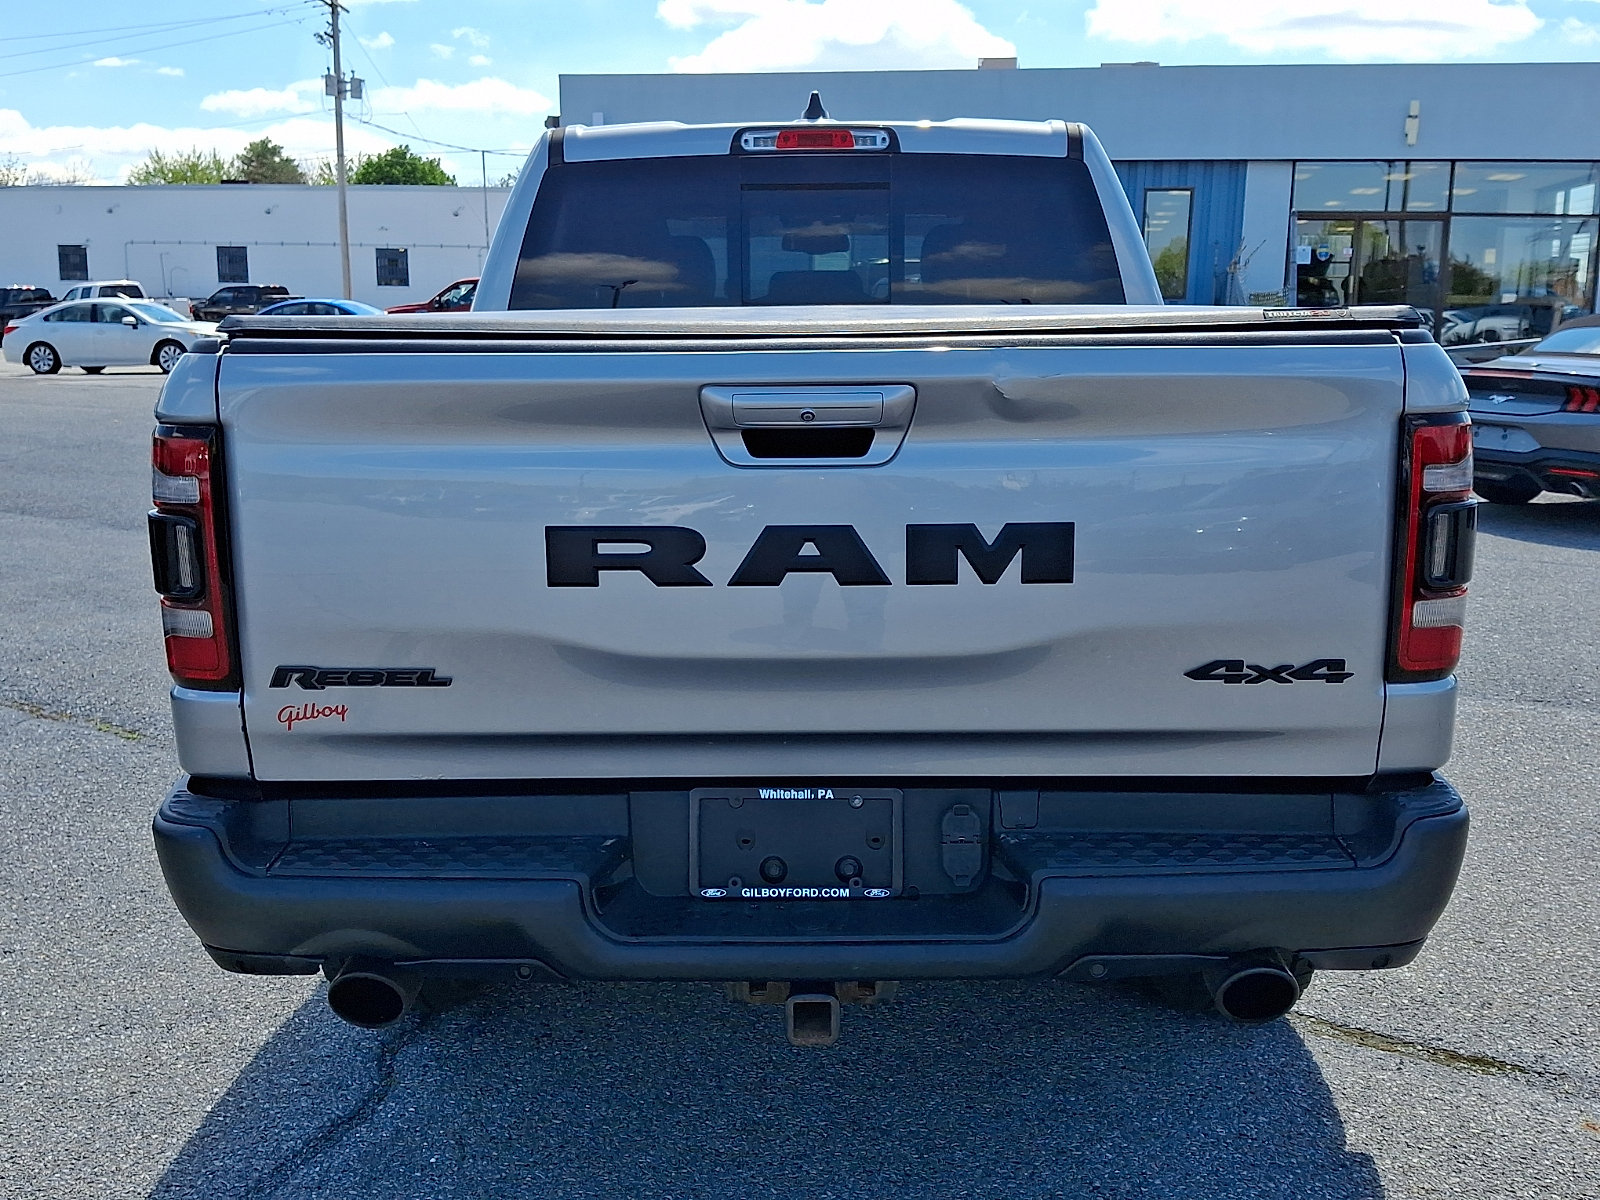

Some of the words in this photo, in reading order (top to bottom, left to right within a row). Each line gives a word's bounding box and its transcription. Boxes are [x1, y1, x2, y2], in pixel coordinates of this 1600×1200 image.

[545, 522, 1075, 588] RAM
[268, 665, 453, 690] REBEL
[277, 702, 349, 731] Gilboy
[759, 789, 815, 799] Whitehall,
[818, 789, 834, 799] PA
[741, 888, 850, 898] GILBOYFORD.COM
